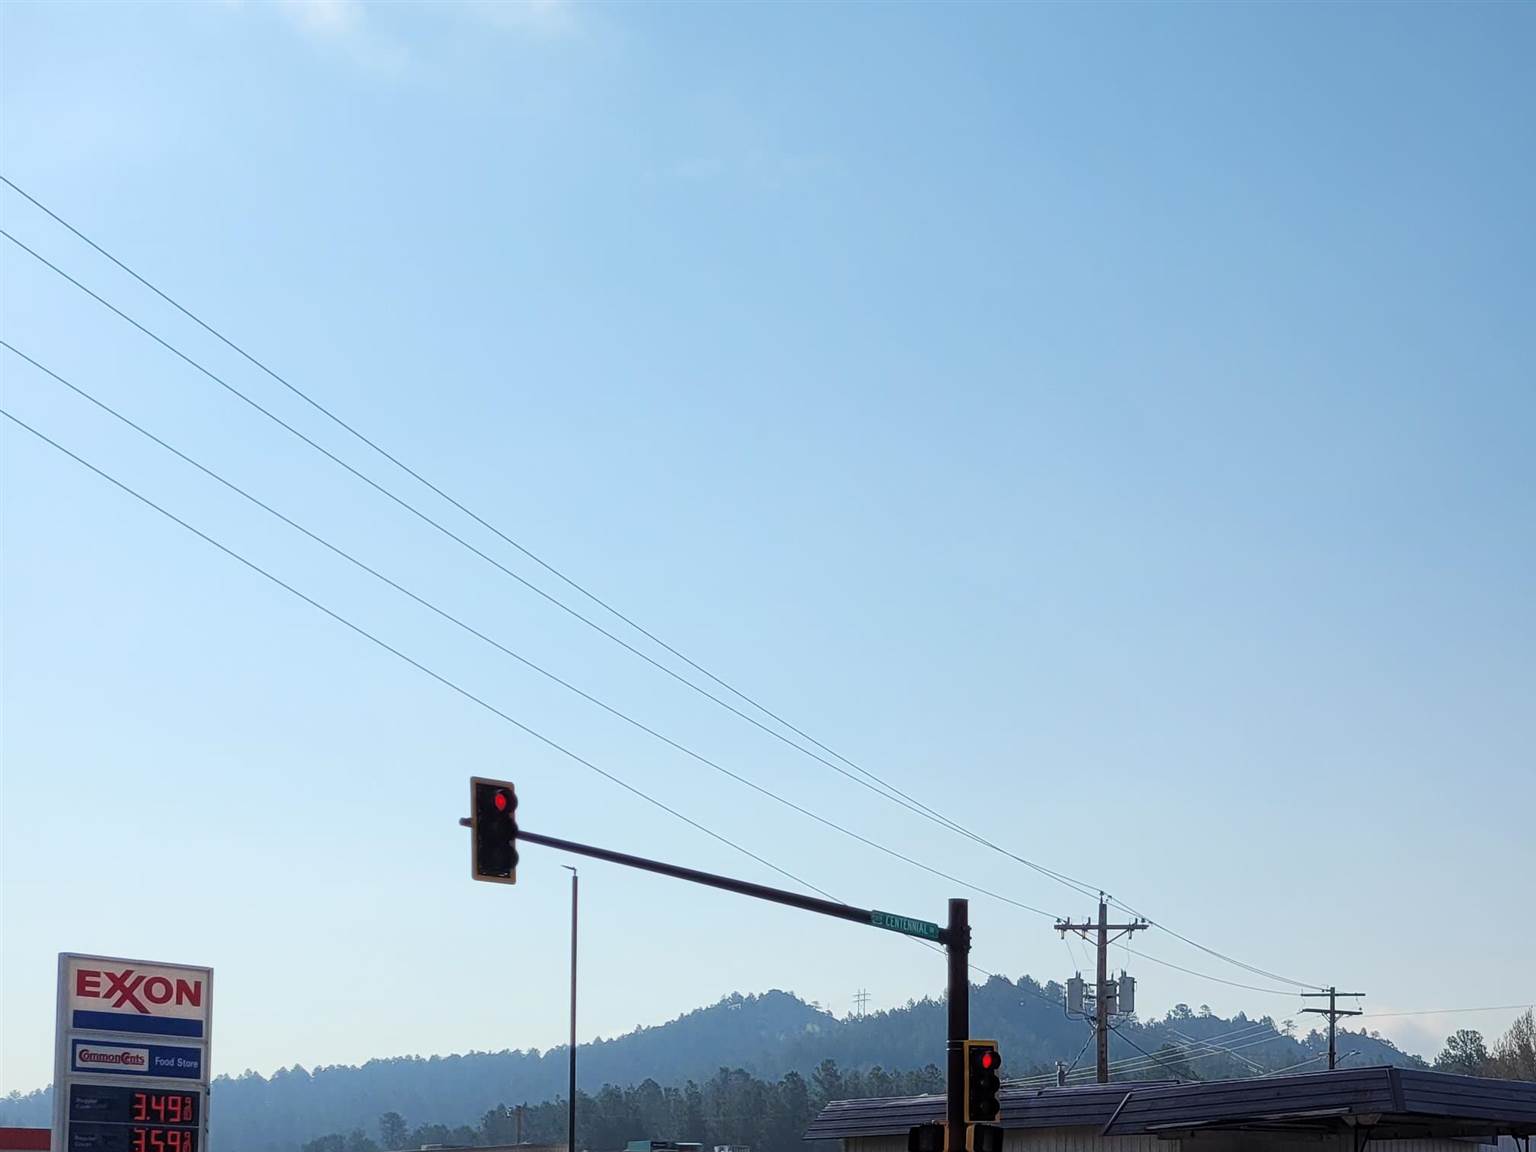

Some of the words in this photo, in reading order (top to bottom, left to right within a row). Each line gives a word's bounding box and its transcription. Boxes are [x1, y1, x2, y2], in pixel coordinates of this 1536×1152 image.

[77, 969, 202, 1014] EXXON
[155, 1056, 175, 1066] Food
[177, 1057, 198, 1068] Store
